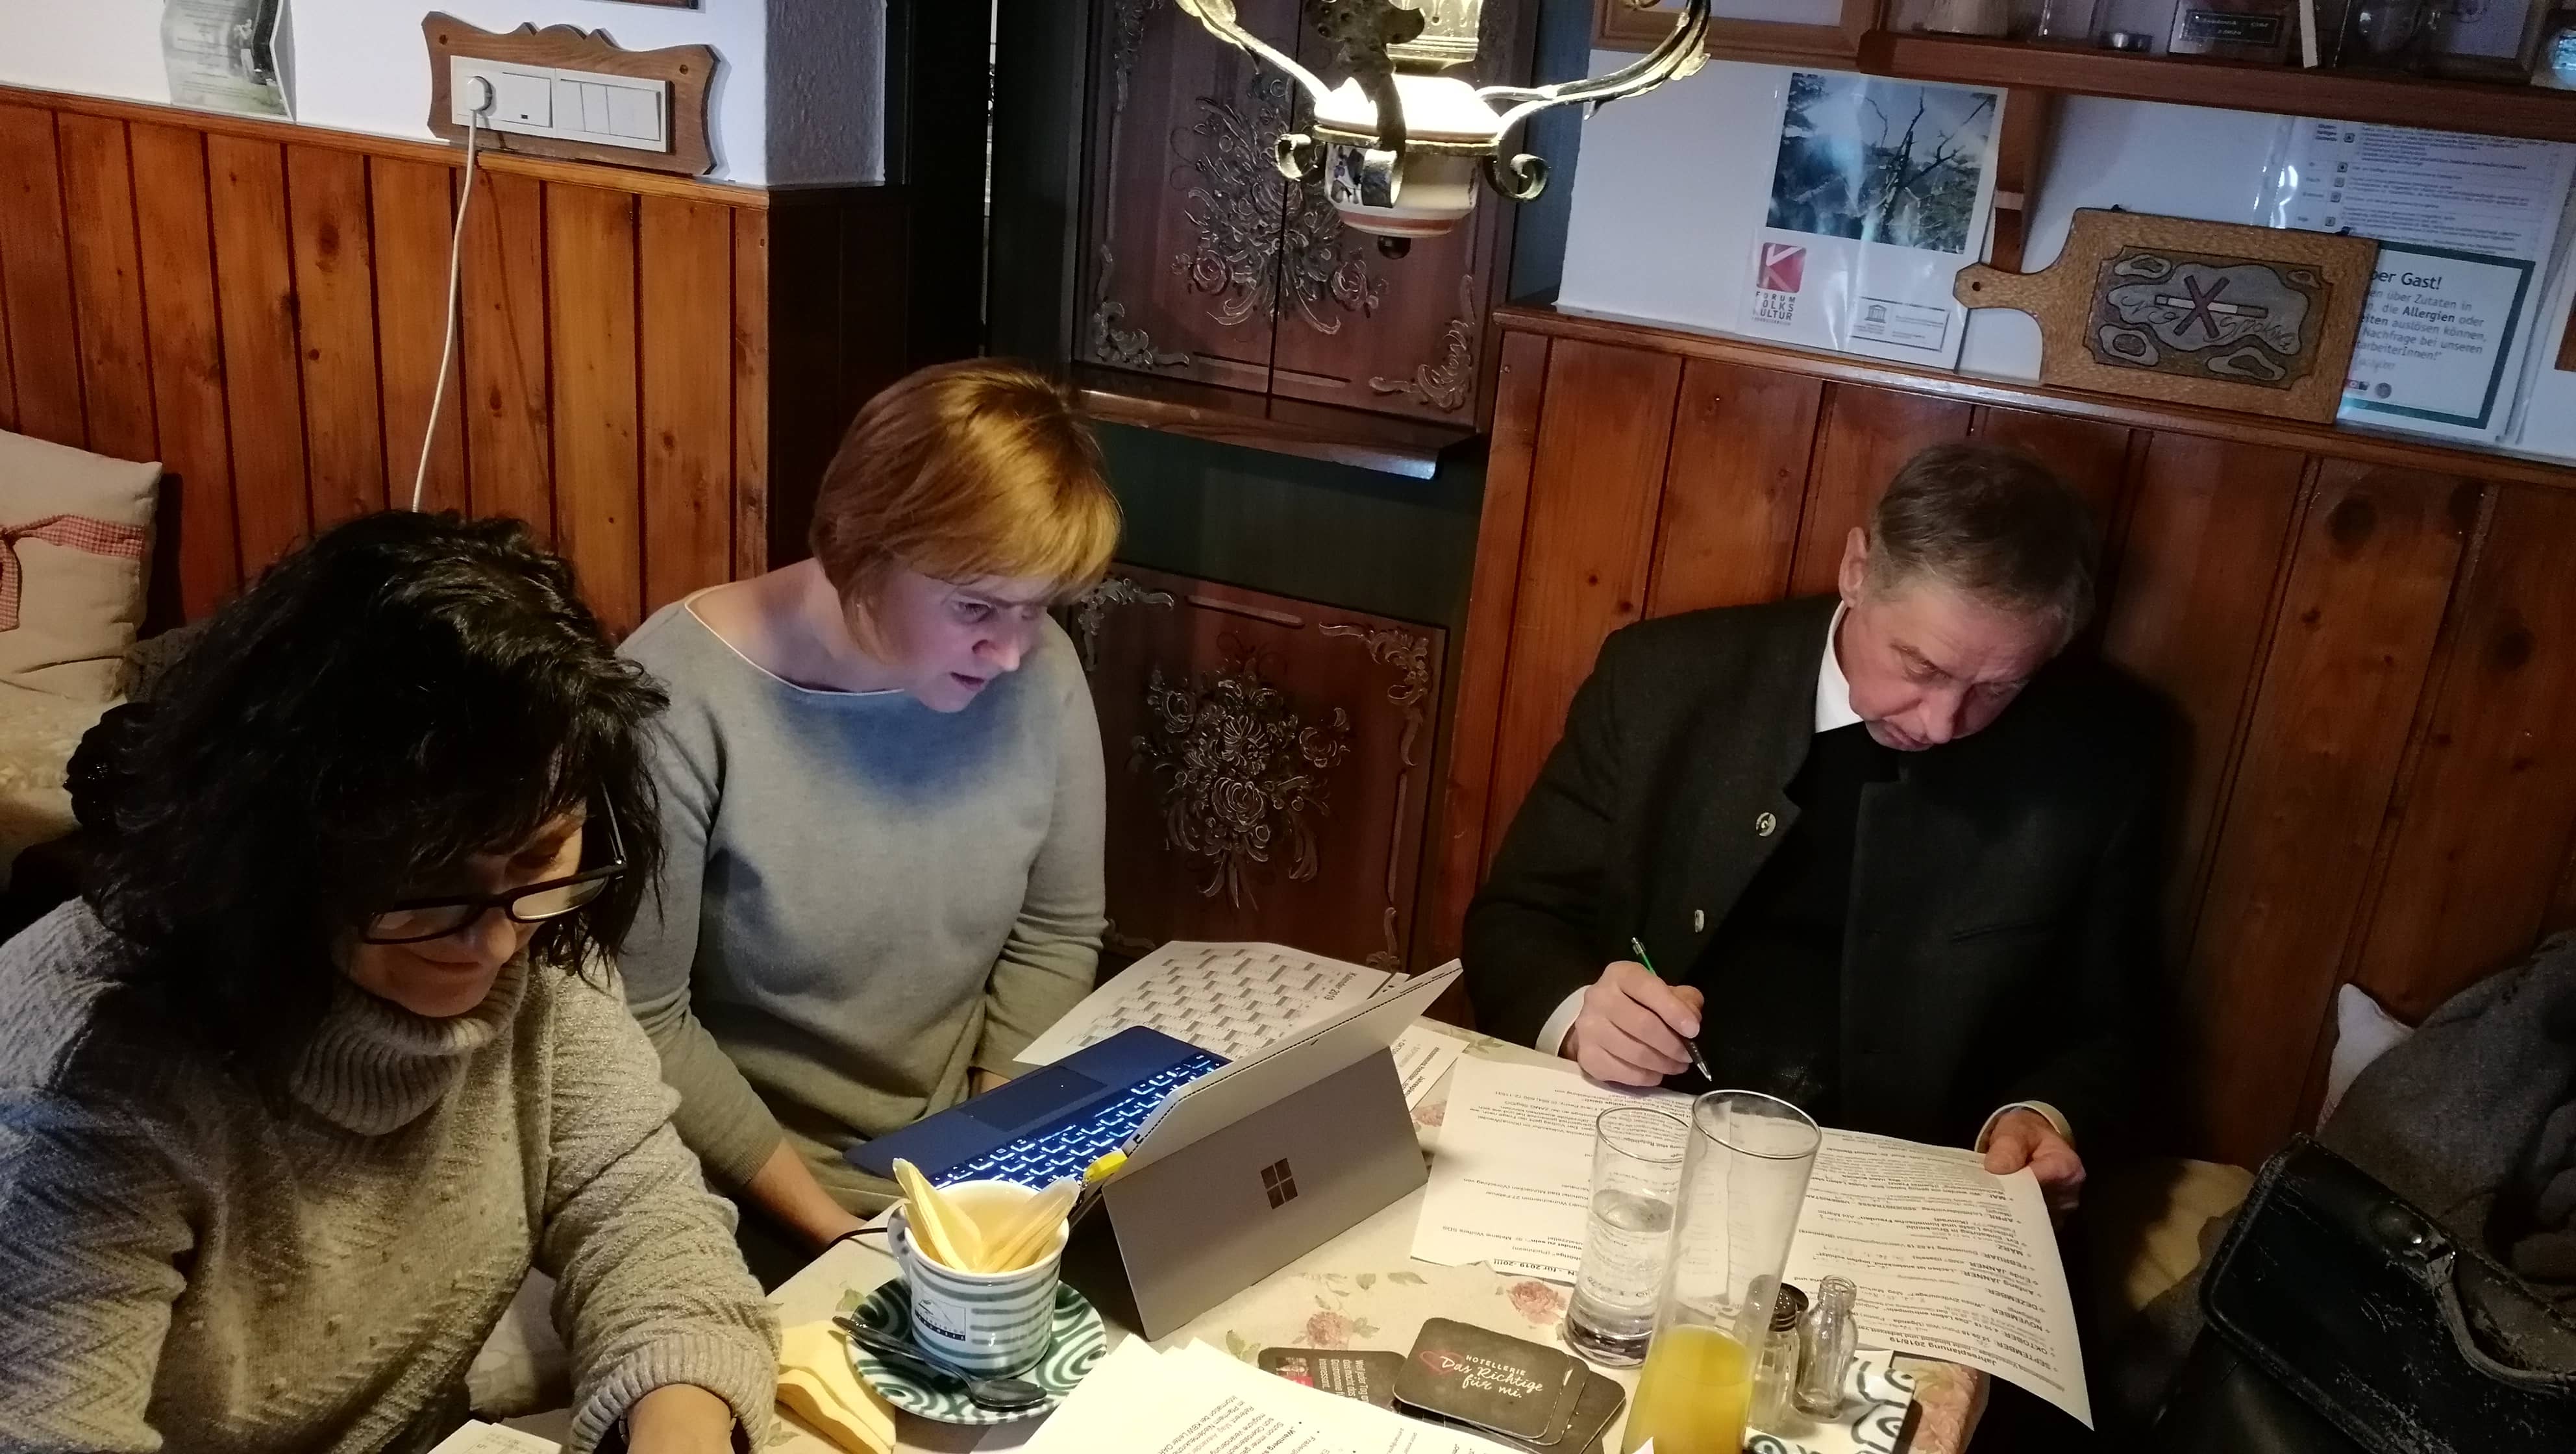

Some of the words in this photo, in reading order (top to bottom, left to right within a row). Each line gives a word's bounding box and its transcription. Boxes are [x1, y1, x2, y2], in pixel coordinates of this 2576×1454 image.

[2401, 272, 2442, 290] Gast!
[2403, 305, 2455, 323] Allergien
[2459, 315, 2484, 327] oder
[2392, 319, 2439, 335] auslösen
[2362, 328, 2415, 345] Nachfrage
[2419, 337, 2436, 347] bei
[1324, 986, 1340, 1004] 2019
[1888, 1336, 1926, 1348] 2018/19
[1927, 1342, 1996, 1366] Jahresplanung
[1441, 1355, 1476, 1374] Das
[1478, 1365, 1544, 1392] Richtige
[1465, 1354, 1526, 1376] HOTELLERIE
[1330, 1359, 1344, 1391] Gastronomie
[1358, 1384, 1368, 1394] Tag
[1462, 1374, 1494, 1392] für
[1498, 1385, 1522, 1399] mi.
[1186, 1420, 1201, 1435] KBW
